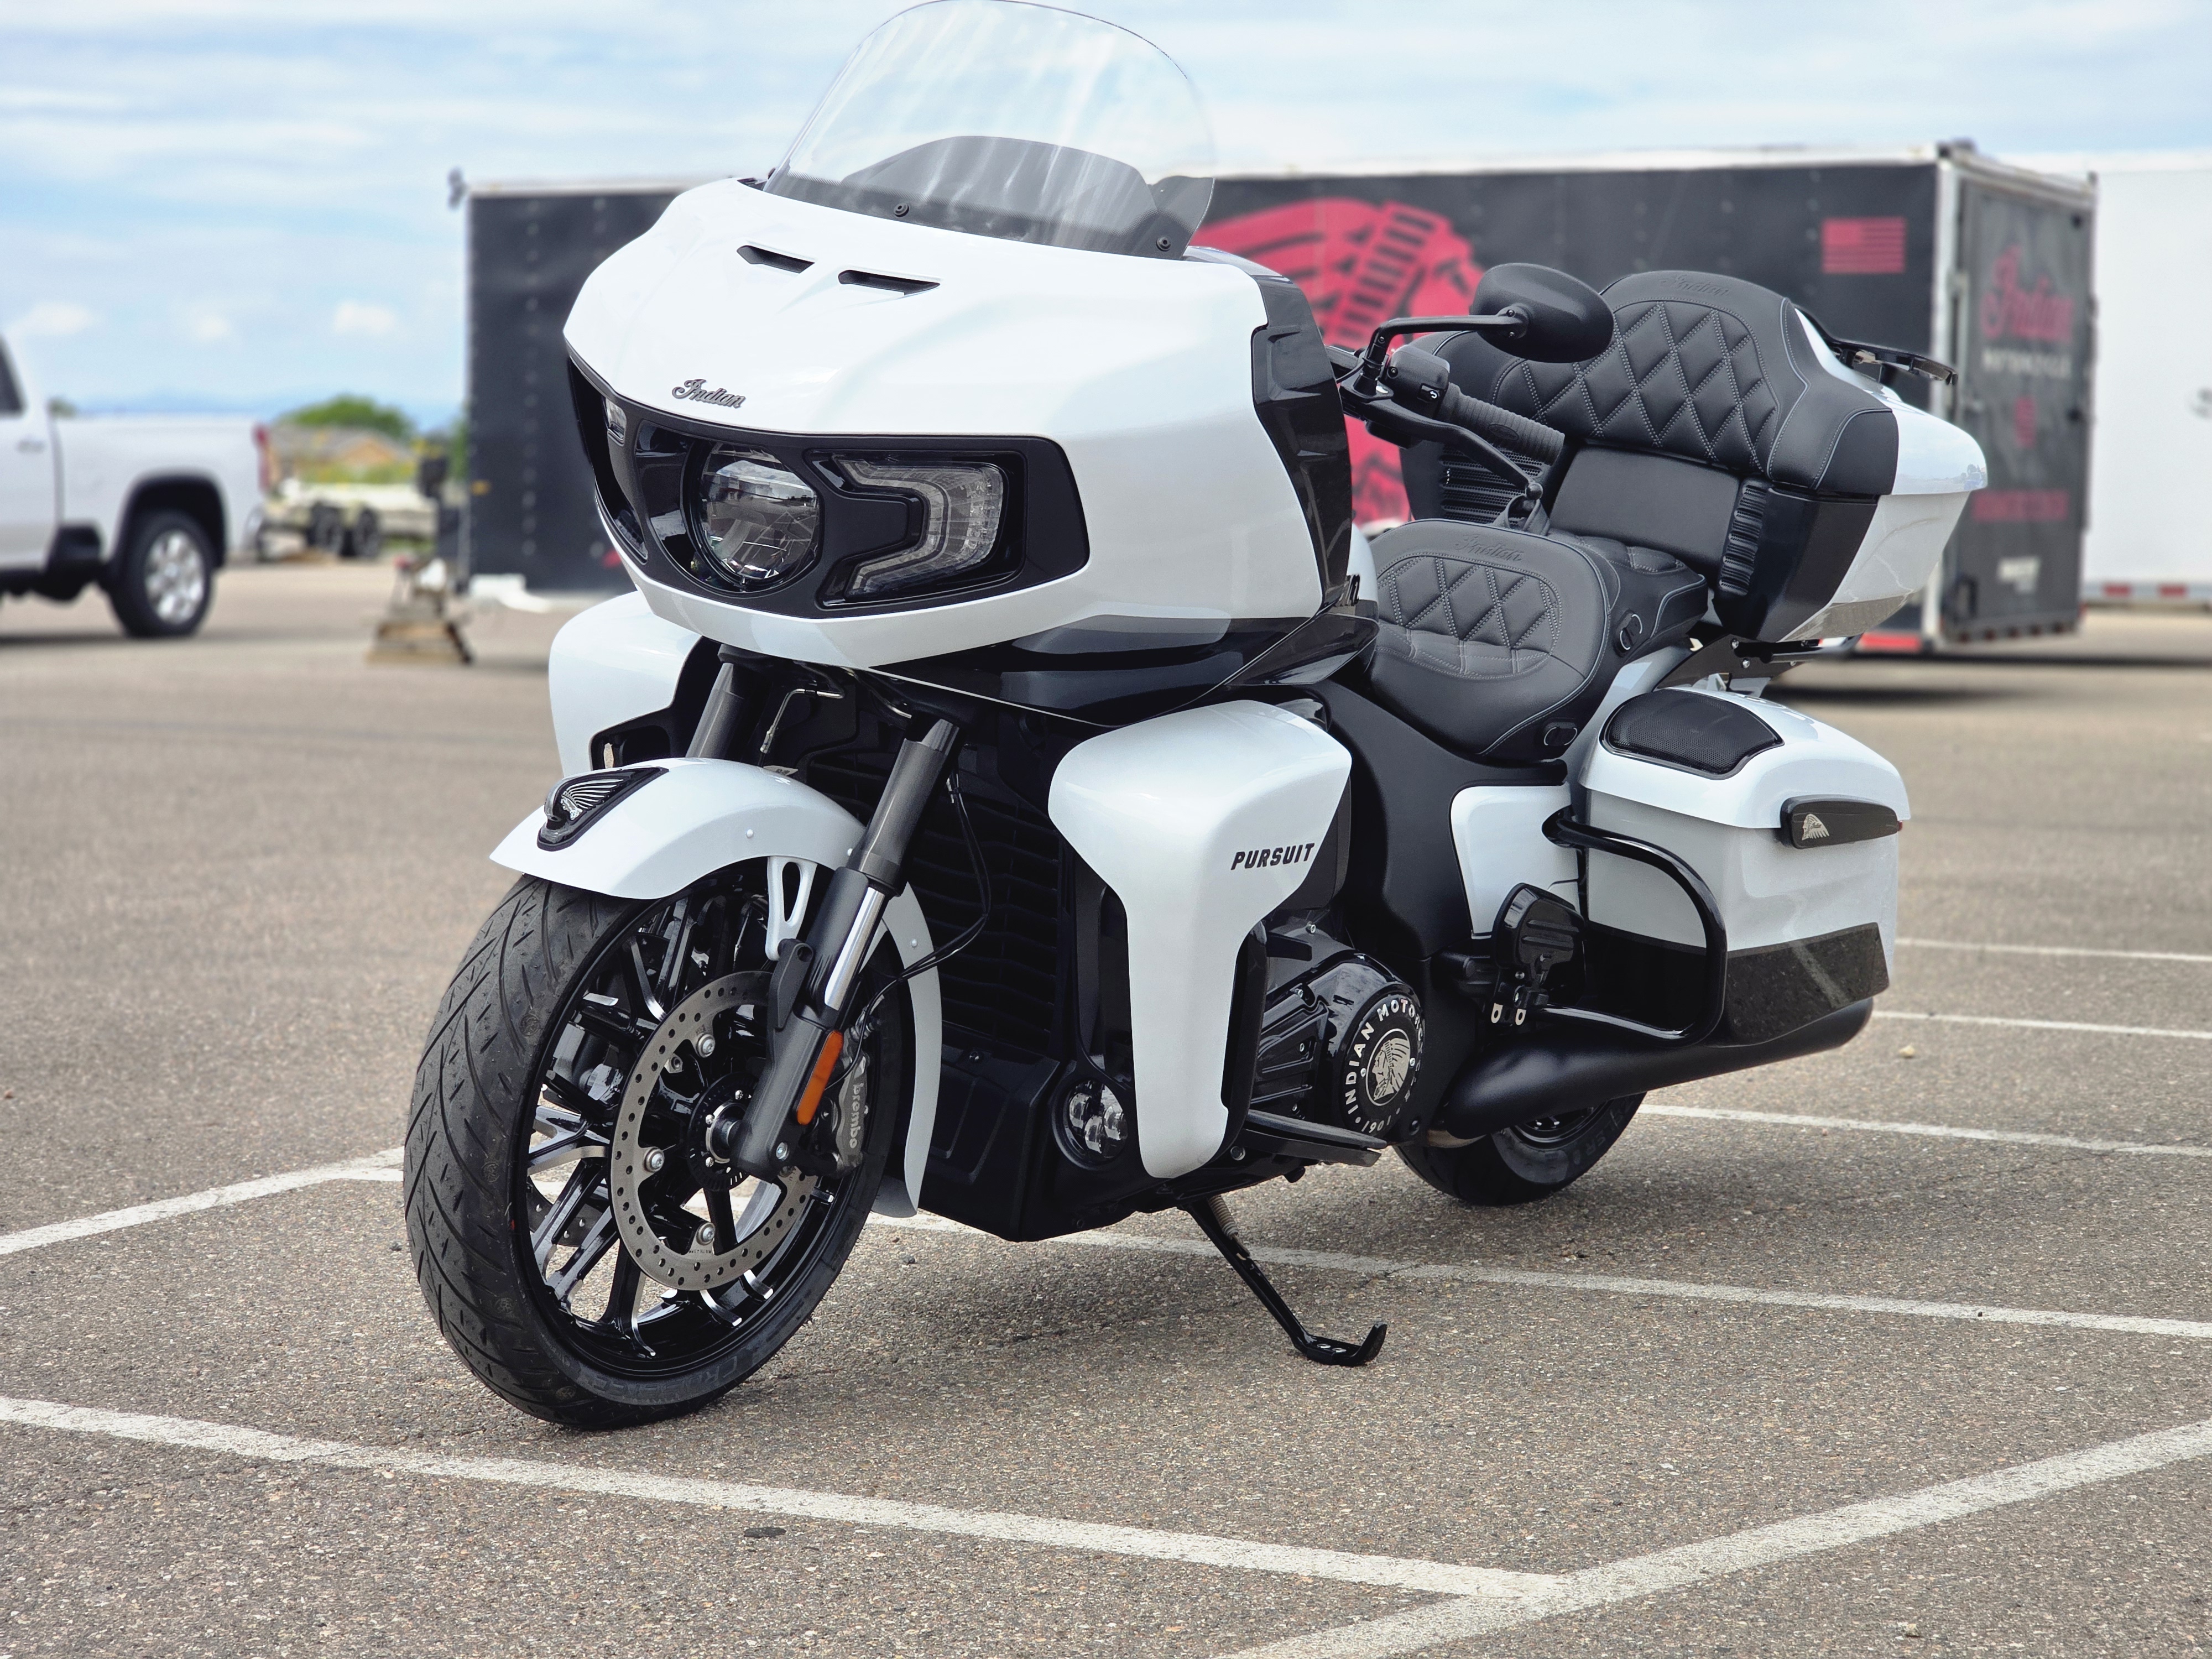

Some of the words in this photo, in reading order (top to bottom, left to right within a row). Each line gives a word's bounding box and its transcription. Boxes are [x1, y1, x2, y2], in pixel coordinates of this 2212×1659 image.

[672, 379, 746, 409] Indian
[1230, 843, 1315, 870] PURSUIT
[1345, 1022, 1375, 1115] INDIAN
[849, 1082, 864, 1149] brembo
[1361, 1115, 1391, 1134] 1901
